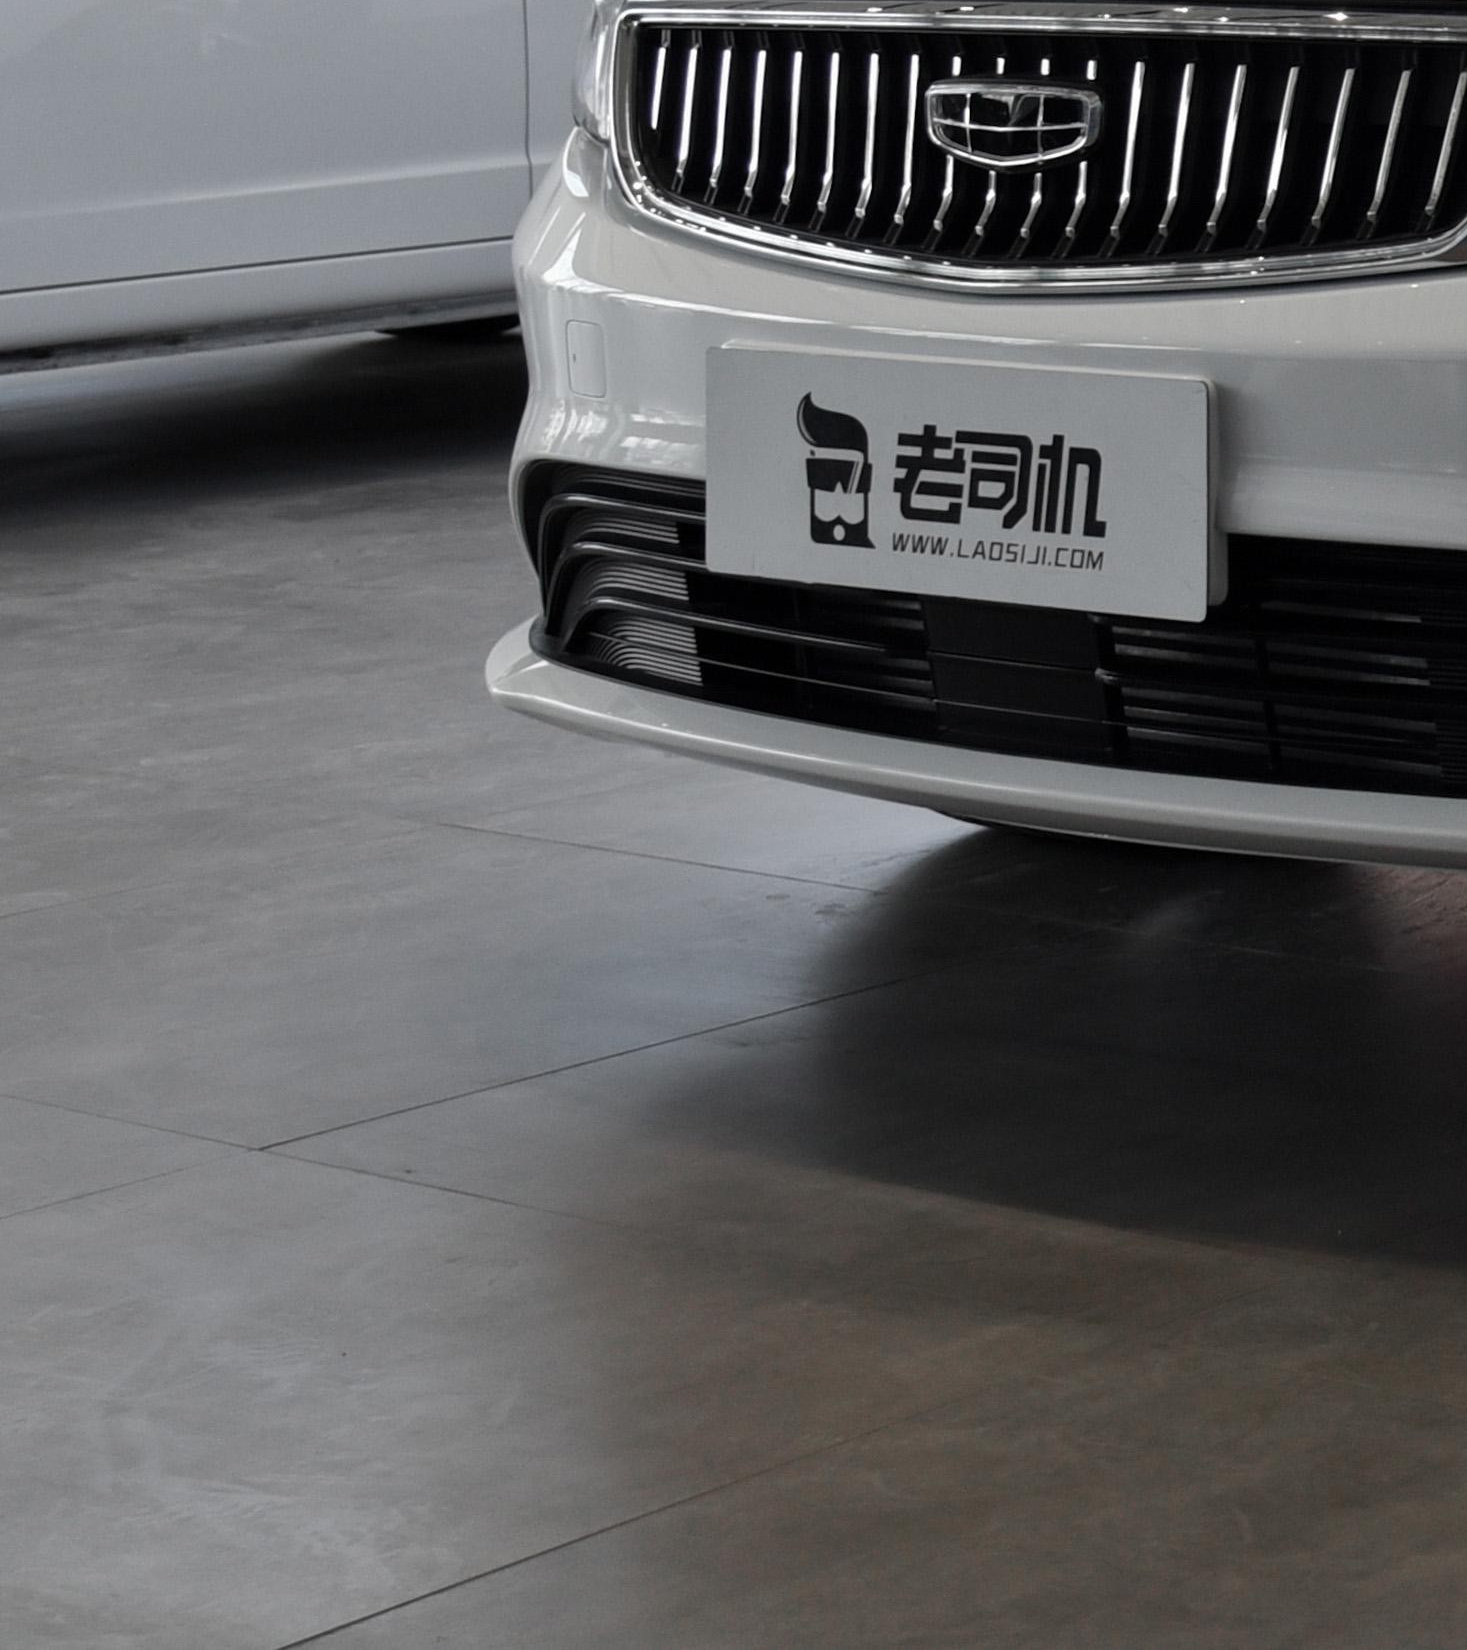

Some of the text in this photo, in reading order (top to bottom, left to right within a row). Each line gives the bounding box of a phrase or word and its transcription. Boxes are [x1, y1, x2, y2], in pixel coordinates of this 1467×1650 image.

[892, 424, 1107, 538] 老司机
[891, 532, 1105, 572] WWW.LAOSIJI.COM
